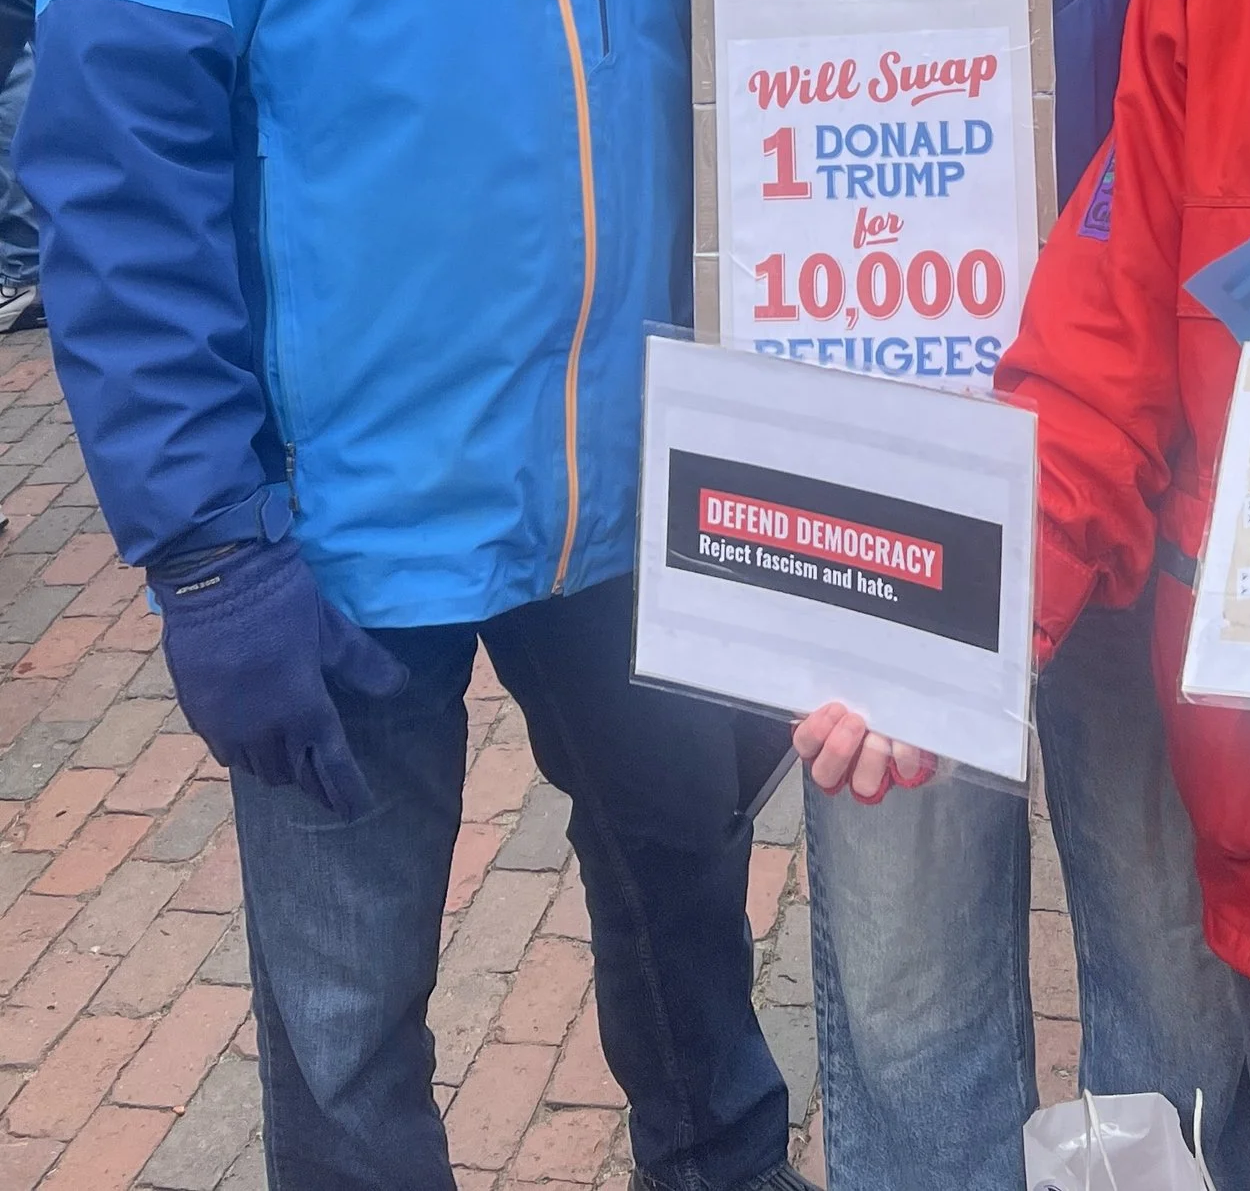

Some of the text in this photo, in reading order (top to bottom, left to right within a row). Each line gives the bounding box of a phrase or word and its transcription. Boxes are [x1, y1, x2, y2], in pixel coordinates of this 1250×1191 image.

[748, 51, 997, 110] Will Swap
[762, 119, 994, 200] 1 DONALD
[816, 161, 966, 200] TRUMP
[853, 207, 904, 249] for
[754, 249, 1005, 331] 10,000
[699, 533, 899, 602] Reject fascism and hate.
[707, 497, 936, 577] DEFEND DEMOCRACY
